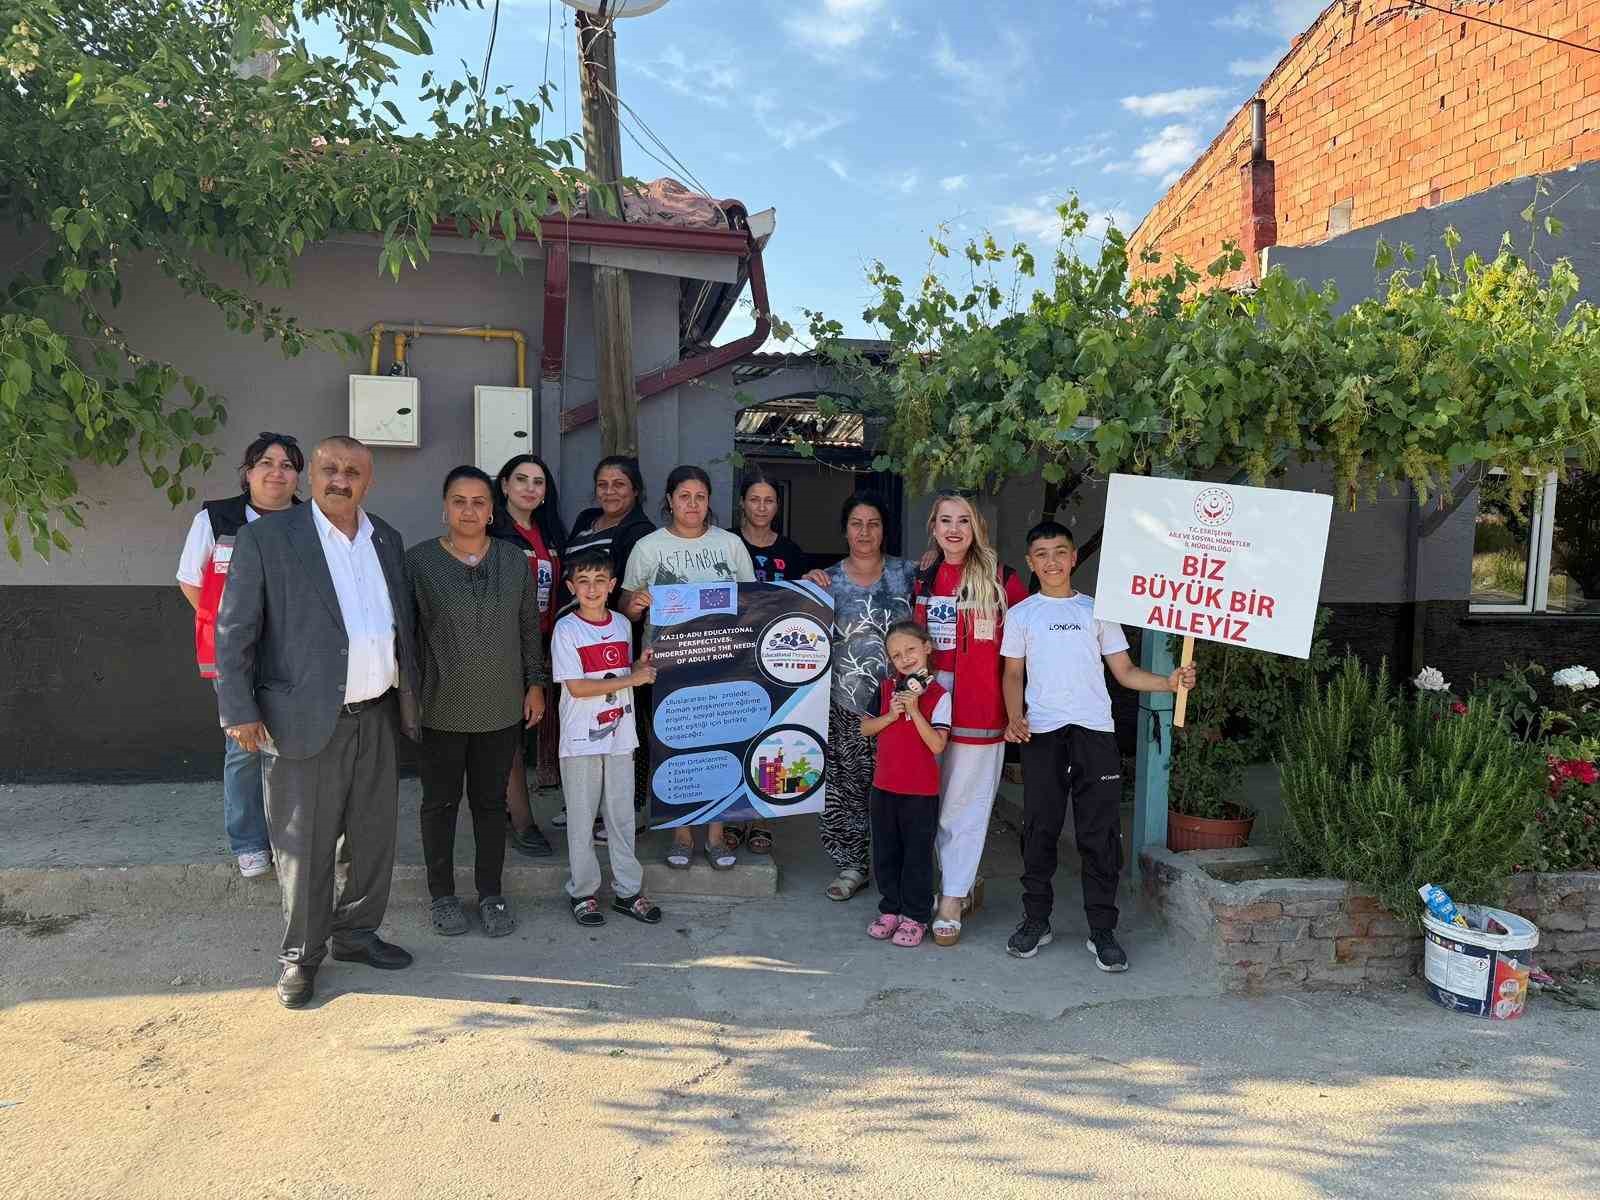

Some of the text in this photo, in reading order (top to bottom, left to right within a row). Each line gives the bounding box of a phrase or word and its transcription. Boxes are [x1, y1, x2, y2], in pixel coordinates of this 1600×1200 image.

[1191, 534, 1215, 542] SOSYAL
[1215, 537, 1251, 547] HİZMETLER
[1182, 553, 1227, 581] BİZ
[1131, 573, 1275, 618] BÜYÜK BİR
[1048, 623, 1081, 631] LONDON
[1147, 603, 1250, 642] AİLEYİZ
[660, 627, 754, 641] KA210-ADU EDUCATIONAL
[678, 637, 733, 648] PERSPECTIVES:
[654, 647, 716, 659] UNDERSTANDING
[733, 642, 757, 650] NEEDS
[688, 655, 711, 663] ADULT
